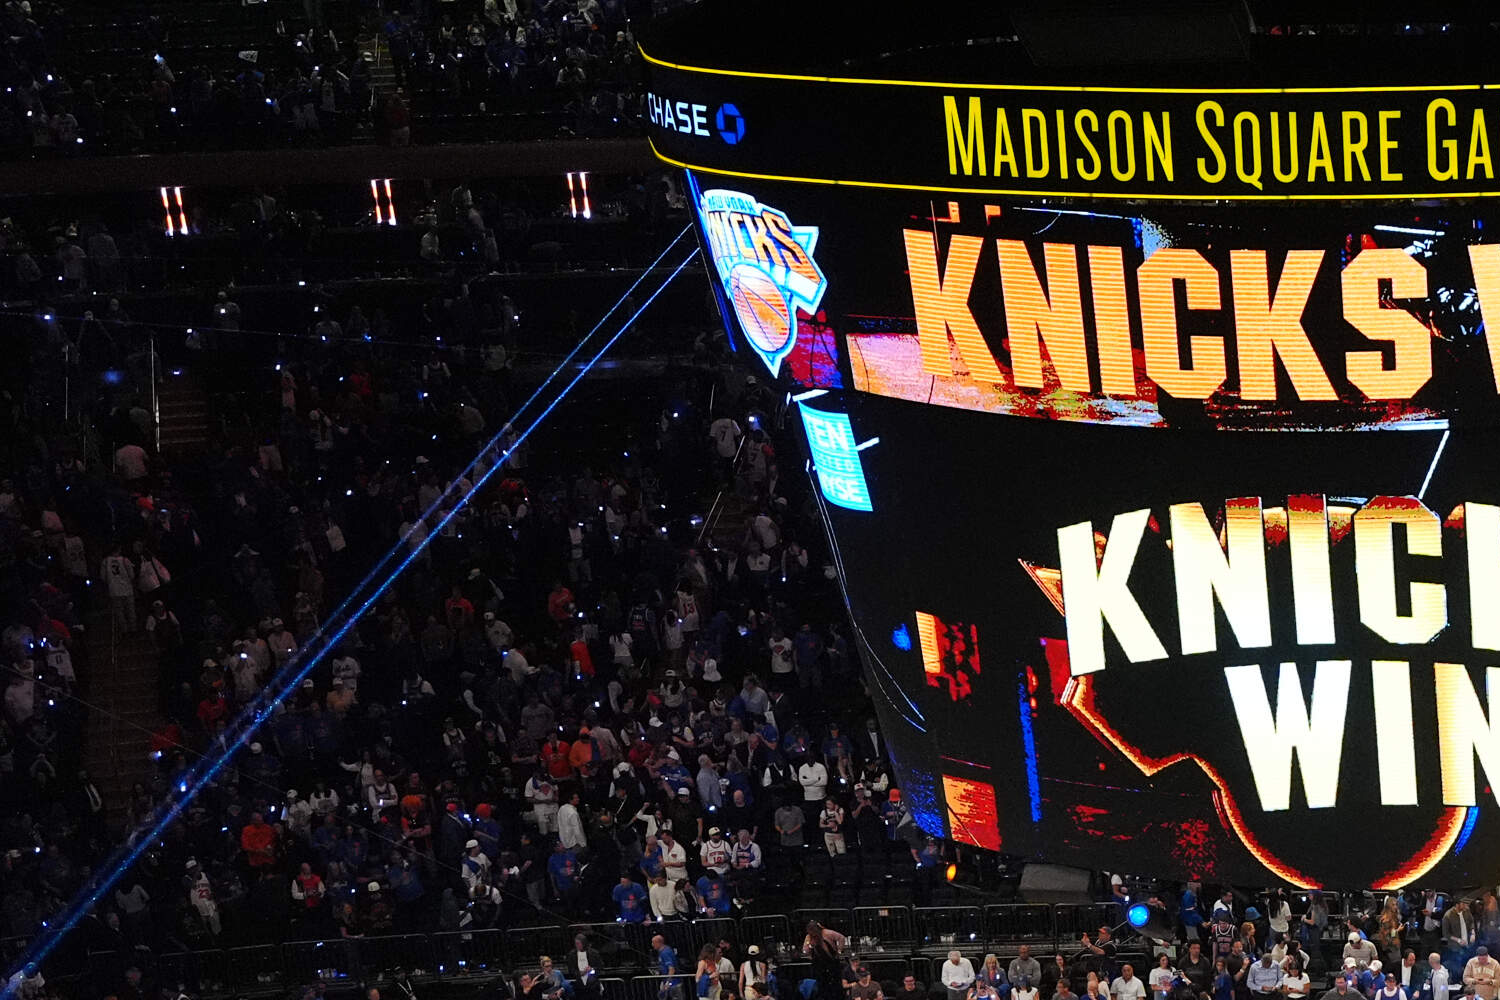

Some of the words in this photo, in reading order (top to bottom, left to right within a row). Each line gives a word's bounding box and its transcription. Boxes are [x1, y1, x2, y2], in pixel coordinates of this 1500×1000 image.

[647, 91, 711, 137] CHASE
[944, 96, 1174, 183] MADISON
[1196, 100, 1403, 191] SQUARE
[903, 228, 1433, 402] KNICKS
